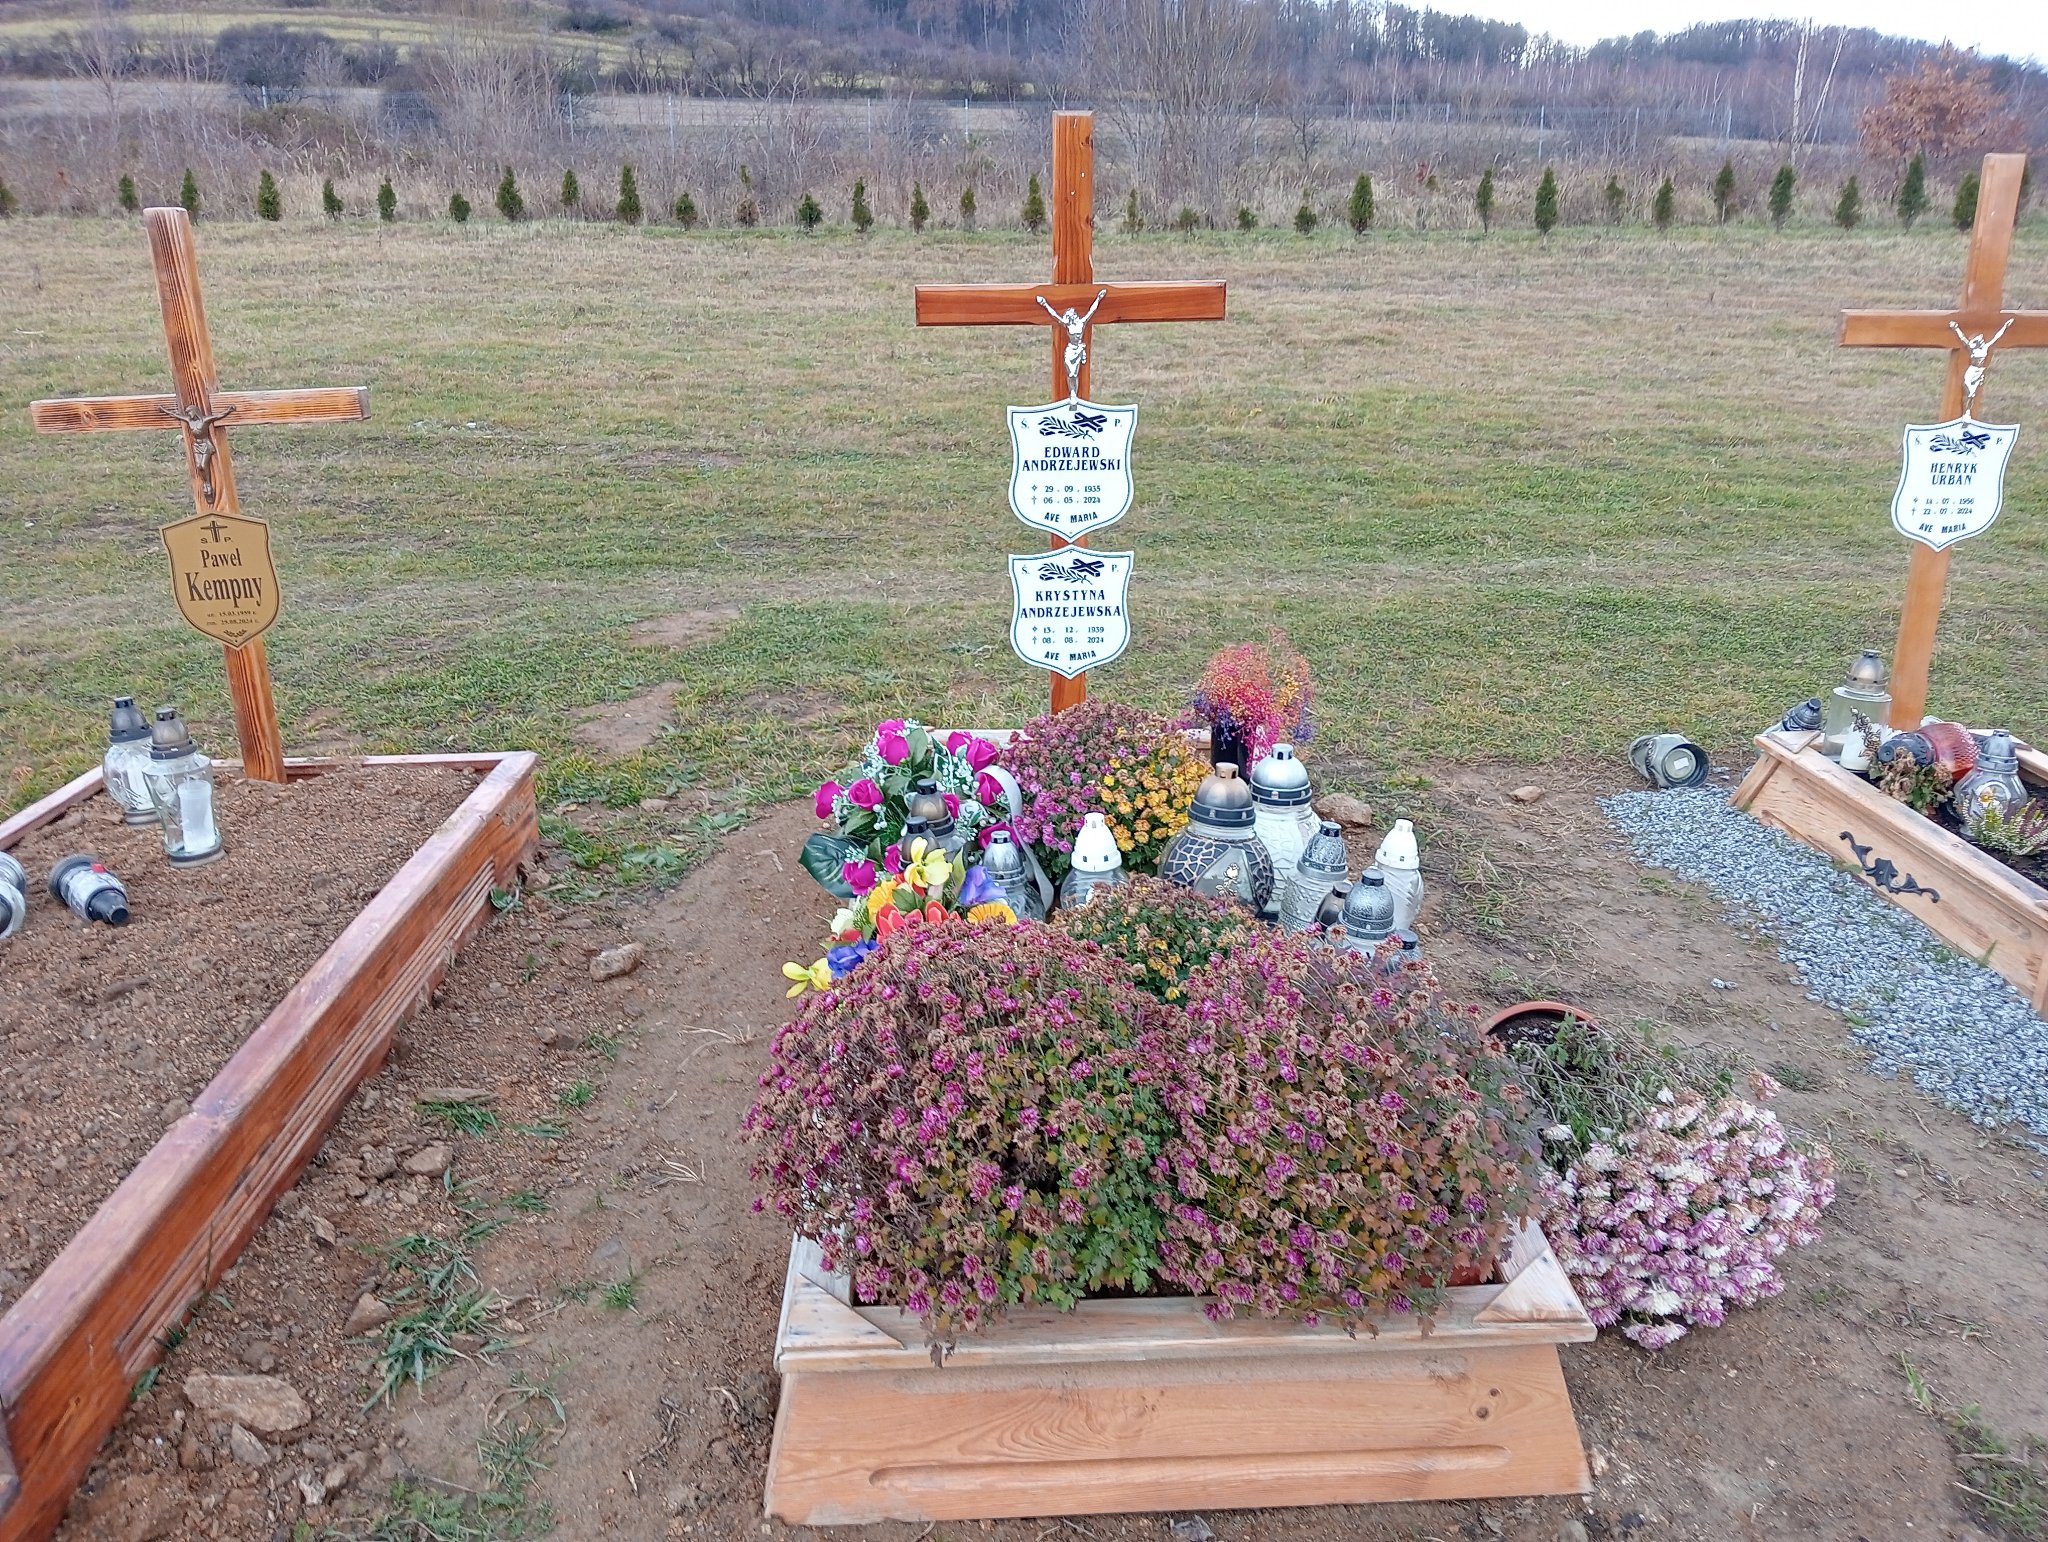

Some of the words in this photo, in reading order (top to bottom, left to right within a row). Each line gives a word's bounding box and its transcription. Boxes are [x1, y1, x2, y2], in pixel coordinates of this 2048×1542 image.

[1044, 446, 1100, 458] EDWARD
[1022, 459, 1121, 471] ANDRZEJEWSKI
[1930, 463, 1978, 474] HENRYK
[1932, 475, 1973, 485] URBAN
[1044, 512, 1060, 523] AVE
[1070, 511, 1098, 523] MARIA
[1919, 523, 1934, 533] AVE
[1941, 523, 1967, 534] MARIA
[184, 571, 262, 608] Kempny
[1035, 590, 1105, 602] KRYSTYNA
[1020, 605, 1121, 618] ANDRZEJEWSKA
[1044, 651, 1060, 661] AVE
[1069, 650, 1097, 661] MARIA
